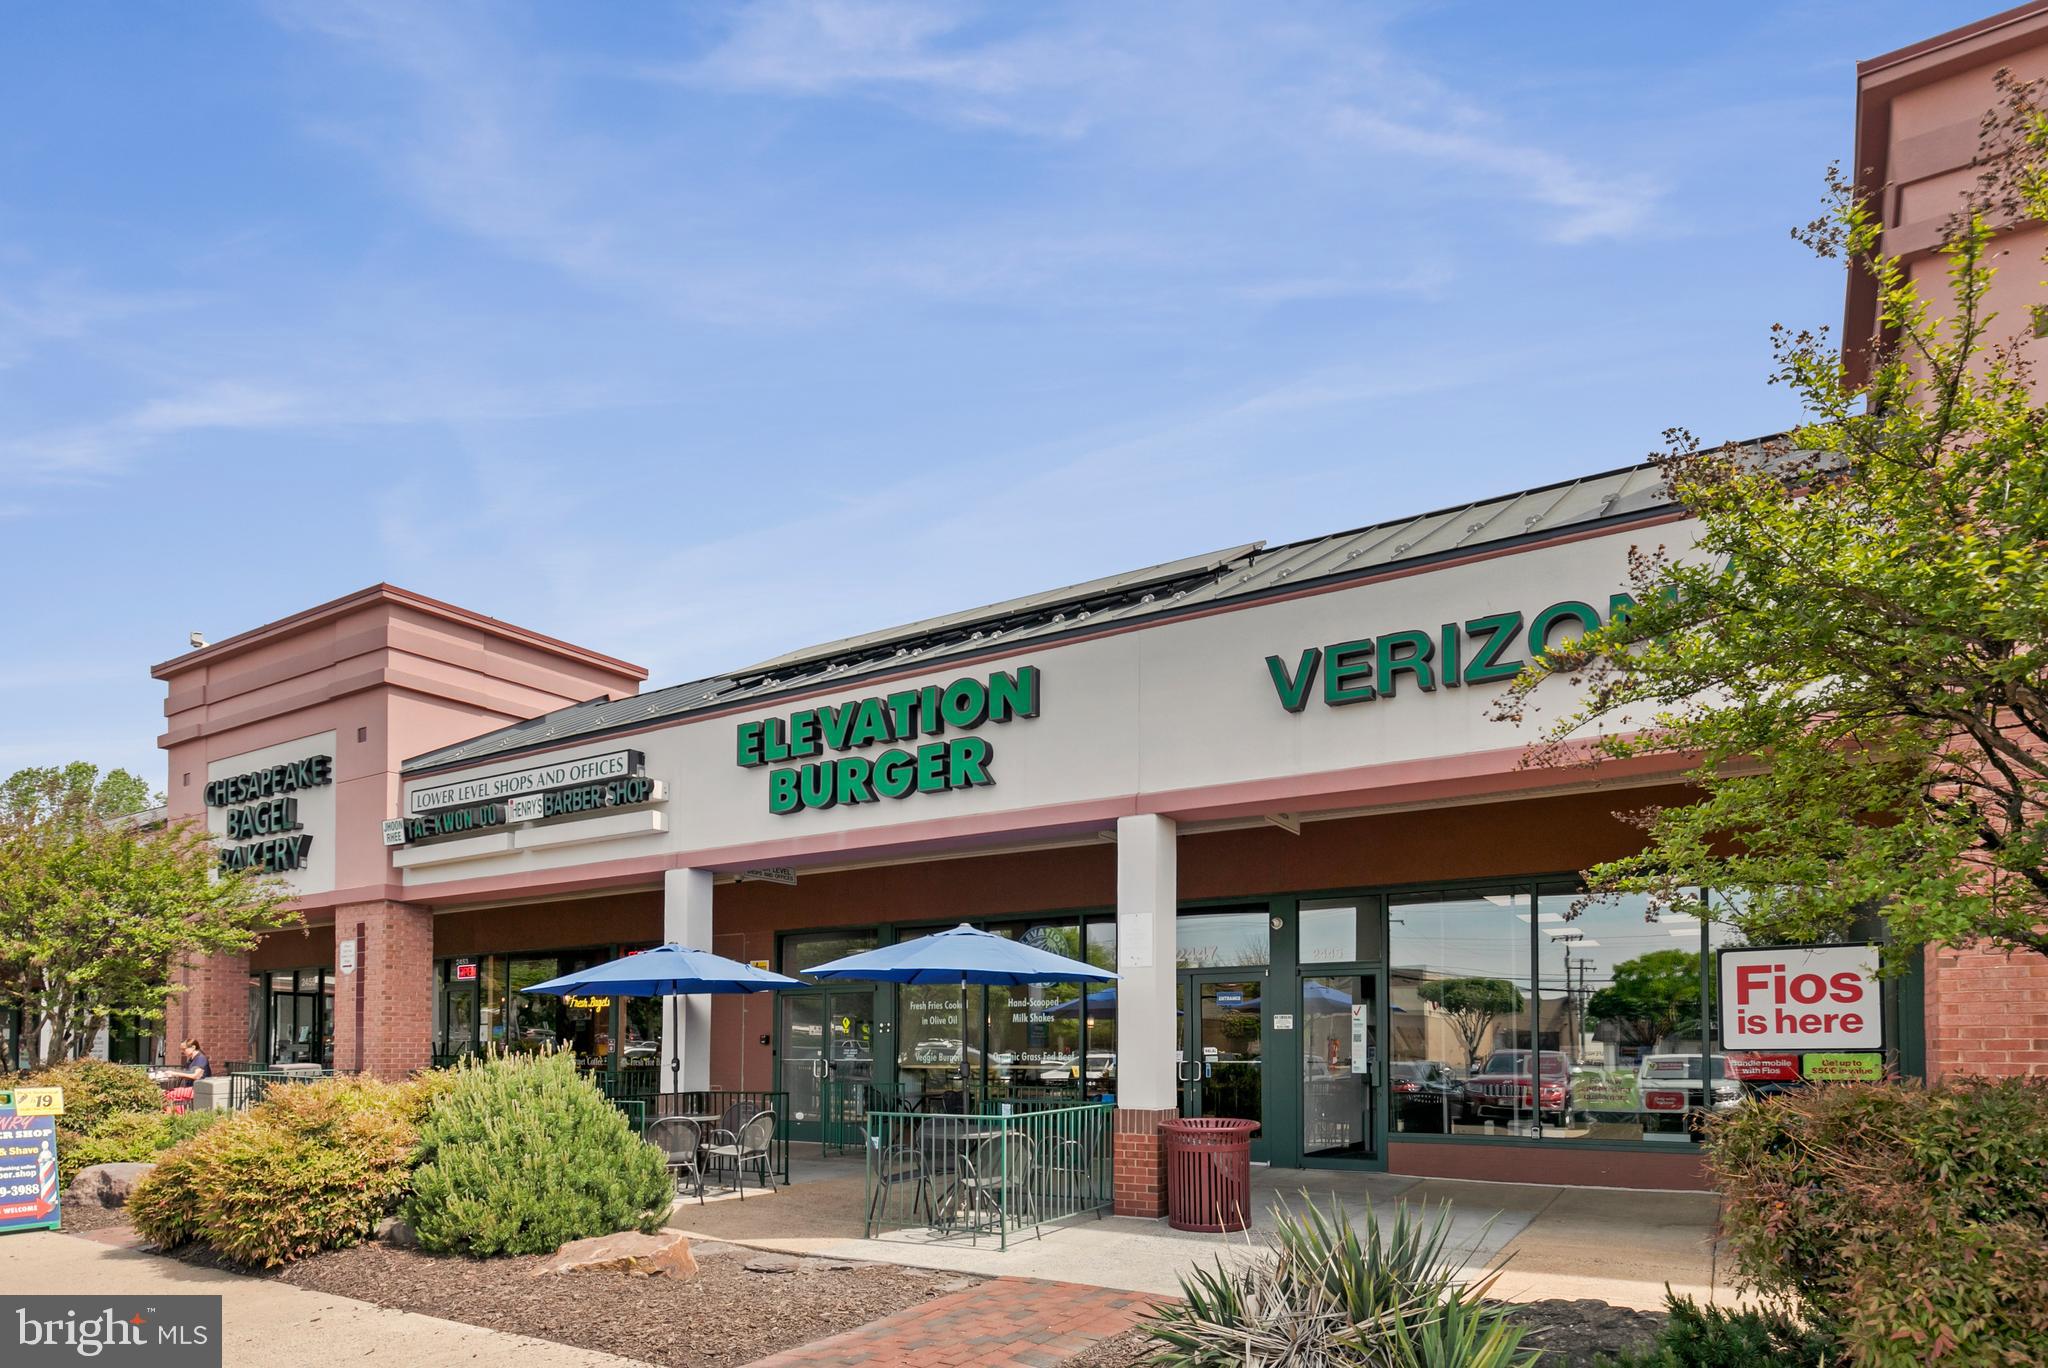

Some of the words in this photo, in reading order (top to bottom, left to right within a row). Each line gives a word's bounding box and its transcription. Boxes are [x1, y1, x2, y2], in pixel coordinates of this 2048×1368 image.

[737, 665, 1040, 768] ELEVATION
[204, 755, 332, 807] CHESAPEAKE
[417, 789, 454, 808] LOWER
[459, 783, 489, 801] LEVEL
[494, 774, 532, 795] SHOPS
[536, 768, 565, 787] AND
[570, 757, 623, 780] OFFICES
[769, 736, 996, 815] BURGER
[510, 797, 543, 819] HENRY'S
[544, 784, 605, 816] BARBER
[606, 777, 654, 807] SHOP
[227, 797, 298, 840] BAGEL
[384, 819, 403, 833] JHOON
[407, 816, 431, 842] TAE
[435, 805, 475, 835] KWON
[479, 803, 503, 829] DO
[386, 831, 403, 842] RHEE
[218, 834, 310, 878] BAKERY
[1175, 945, 1218, 962] 2447
[1736, 964, 1864, 1005] Fios
[569, 995, 587, 1007] Fresh
[588, 996, 610, 1012] Bagels
[910, 1001, 926, 1010] Fresh
[928, 1001, 943, 1010] Fries
[1008, 997, 1059, 1008] Hand-Scooped
[921, 1016, 928, 1025] in
[930, 1015, 946, 1025] Olive
[948, 1015, 958, 1025] Oil
[1012, 1013, 1028, 1022] Milk
[1030, 1013, 1055, 1022] Shakes
[1737, 1008, 1768, 1035] is
[1775, 1008, 1864, 1034] here
[915, 1052, 937, 1064] Veggie
[1021, 1052, 1041, 1060] Grass
[36, 1095, 53, 1107] 19
[15, 1129, 53, 1138] SHOP
[9, 1146, 39, 1155] Shave
[3, 1205, 38, 1214] WELCOME
